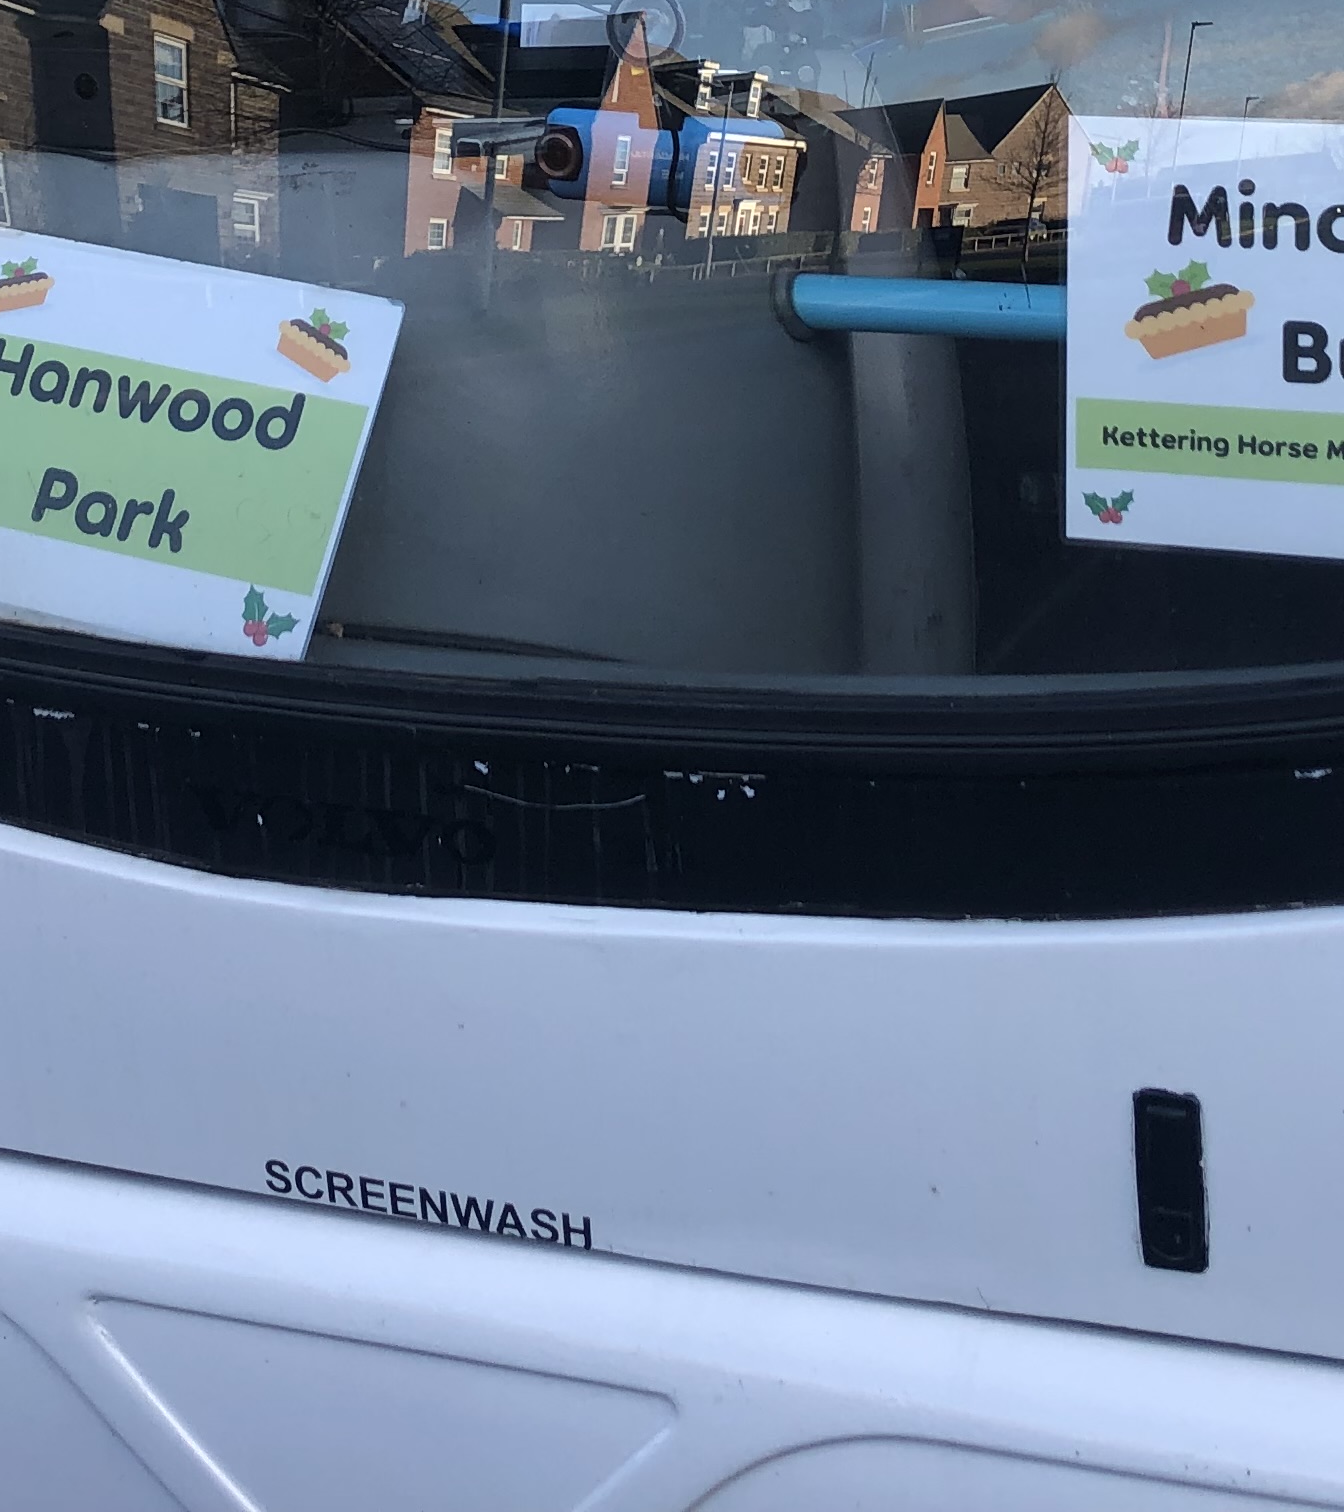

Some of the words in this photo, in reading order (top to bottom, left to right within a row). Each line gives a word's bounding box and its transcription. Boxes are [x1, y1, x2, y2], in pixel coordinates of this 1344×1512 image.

[1102, 425, 1230, 458] Kettering
[1238, 434, 1319, 460] Horse
[30, 467, 190, 554] Park
[264, 1159, 593, 1250] SCREENWASH
